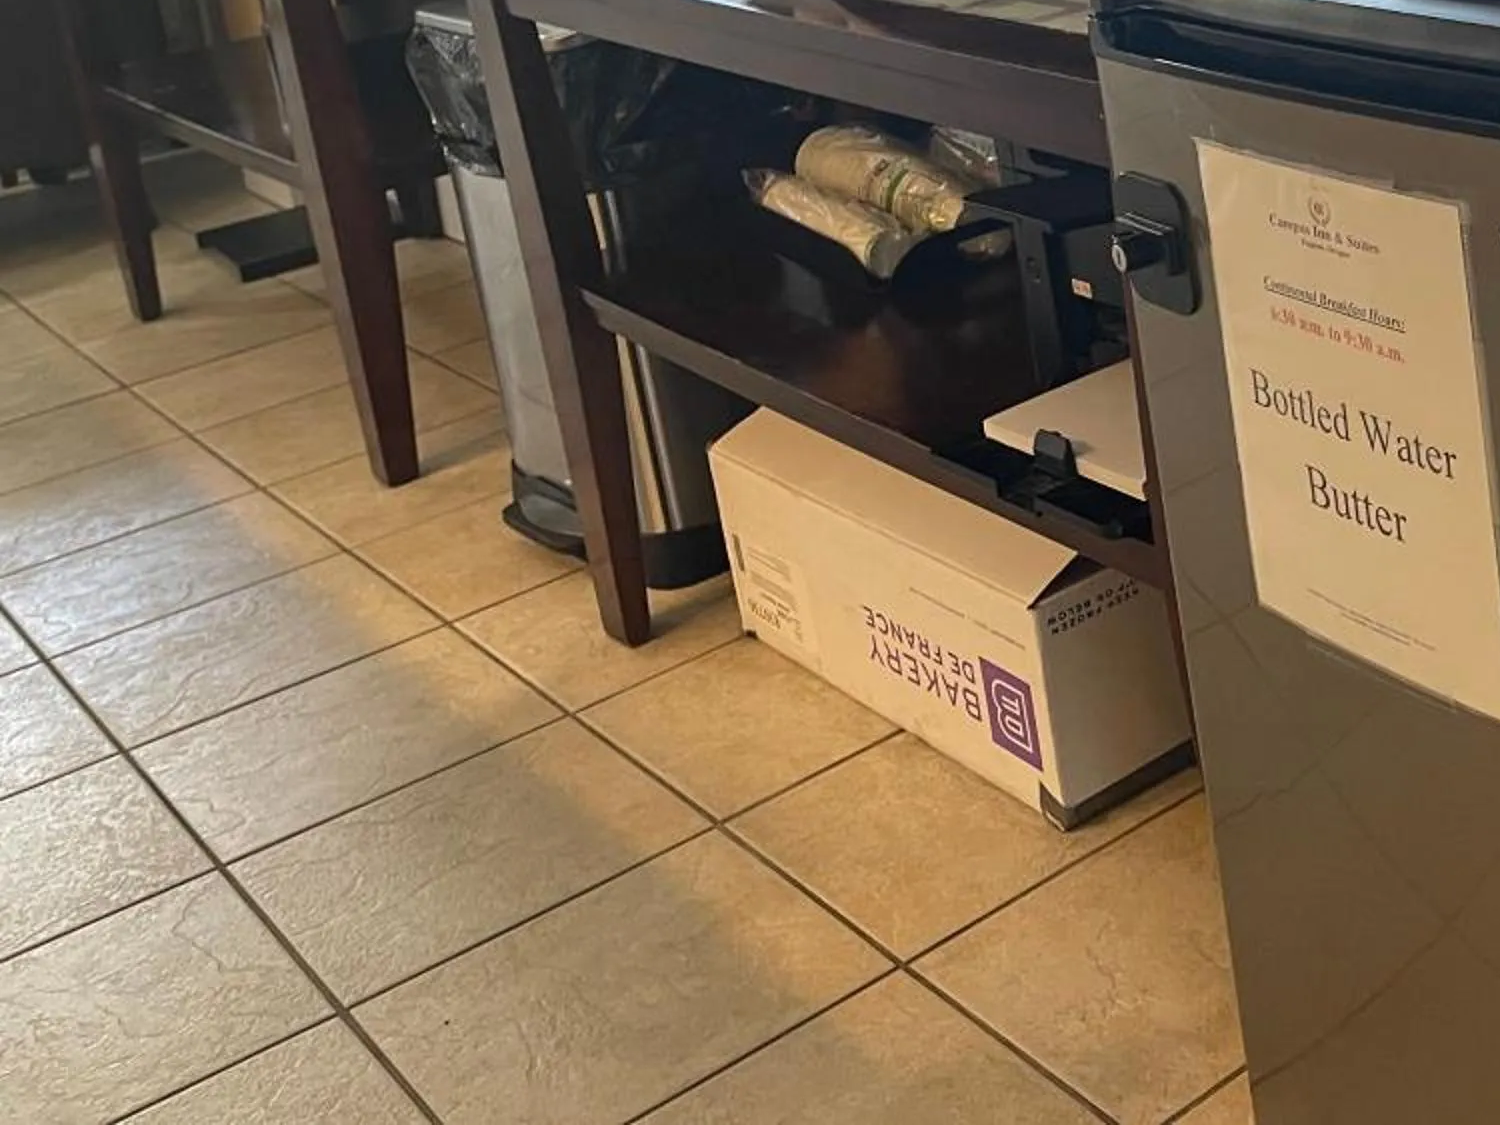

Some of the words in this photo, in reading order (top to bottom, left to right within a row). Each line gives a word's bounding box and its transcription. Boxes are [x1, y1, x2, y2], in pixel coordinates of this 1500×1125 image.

[1269, 212, 1310, 236] Campus
[1313, 225, 1332, 242] Inn
[1333, 232, 1344, 245] &
[1346, 235, 1380, 254] Suites
[1263, 275, 1317, 304] Continental
[1319, 292, 1367, 319] Breakfast
[1369, 308, 1405, 331] Hours:
[1328, 326, 1341, 342] to
[1249, 368, 1350, 443] Bottled
[1359, 410, 1457, 480] Water
[1304, 464, 1407, 543] Butter
[862, 606, 943, 666] FRANCE
[1046, 599, 1091, 627] BELOW
[868, 634, 983, 722] BAKERY
[947, 651, 976, 685] DE
